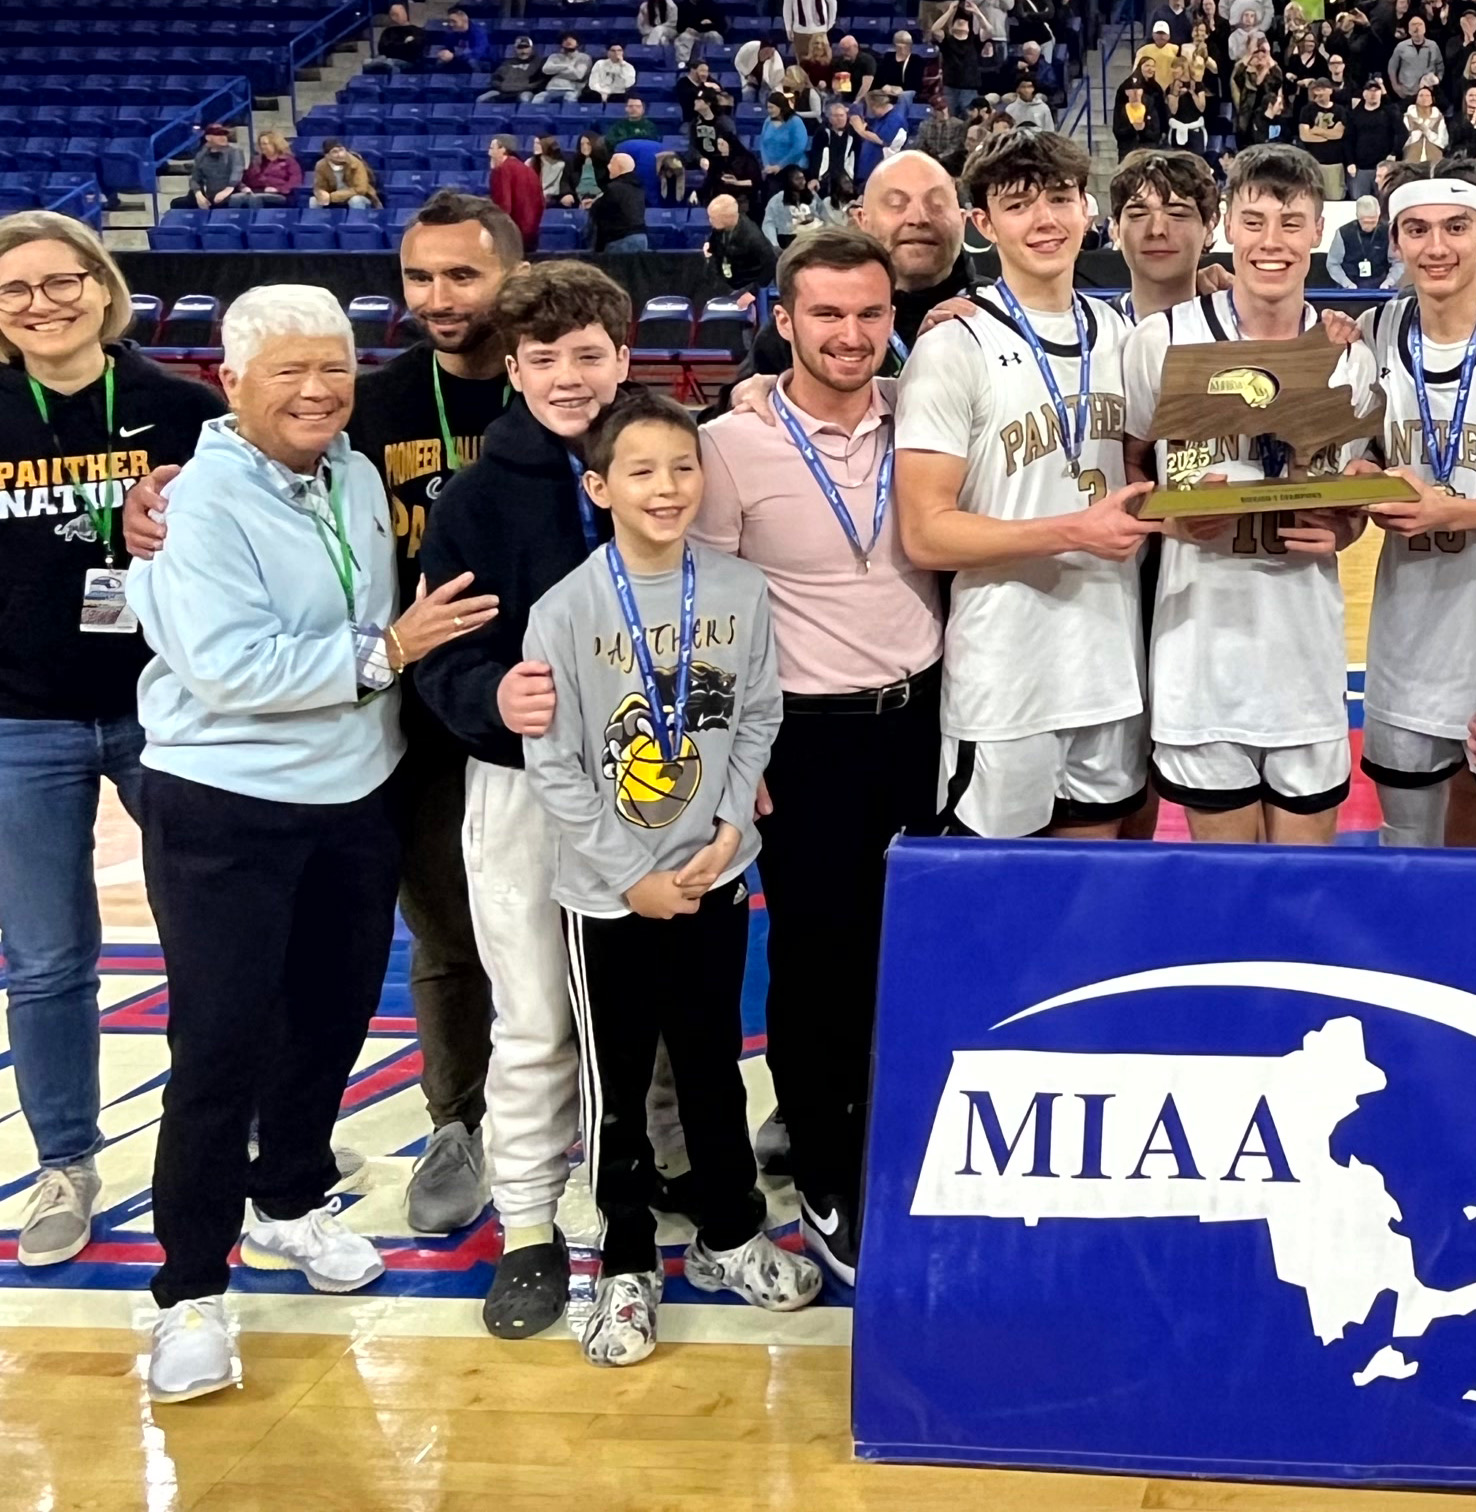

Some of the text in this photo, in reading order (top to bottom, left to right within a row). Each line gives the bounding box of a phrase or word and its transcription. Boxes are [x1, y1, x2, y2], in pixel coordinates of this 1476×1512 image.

[1000, 392, 1126, 477] PANTHE
[0, 450, 150, 489] PANTHER
[385, 438, 441, 491] PIONEER
[1167, 448, 1211, 474] 2025
[0, 478, 137, 519] NATIO
[954, 1090, 1300, 1184] MIAA
